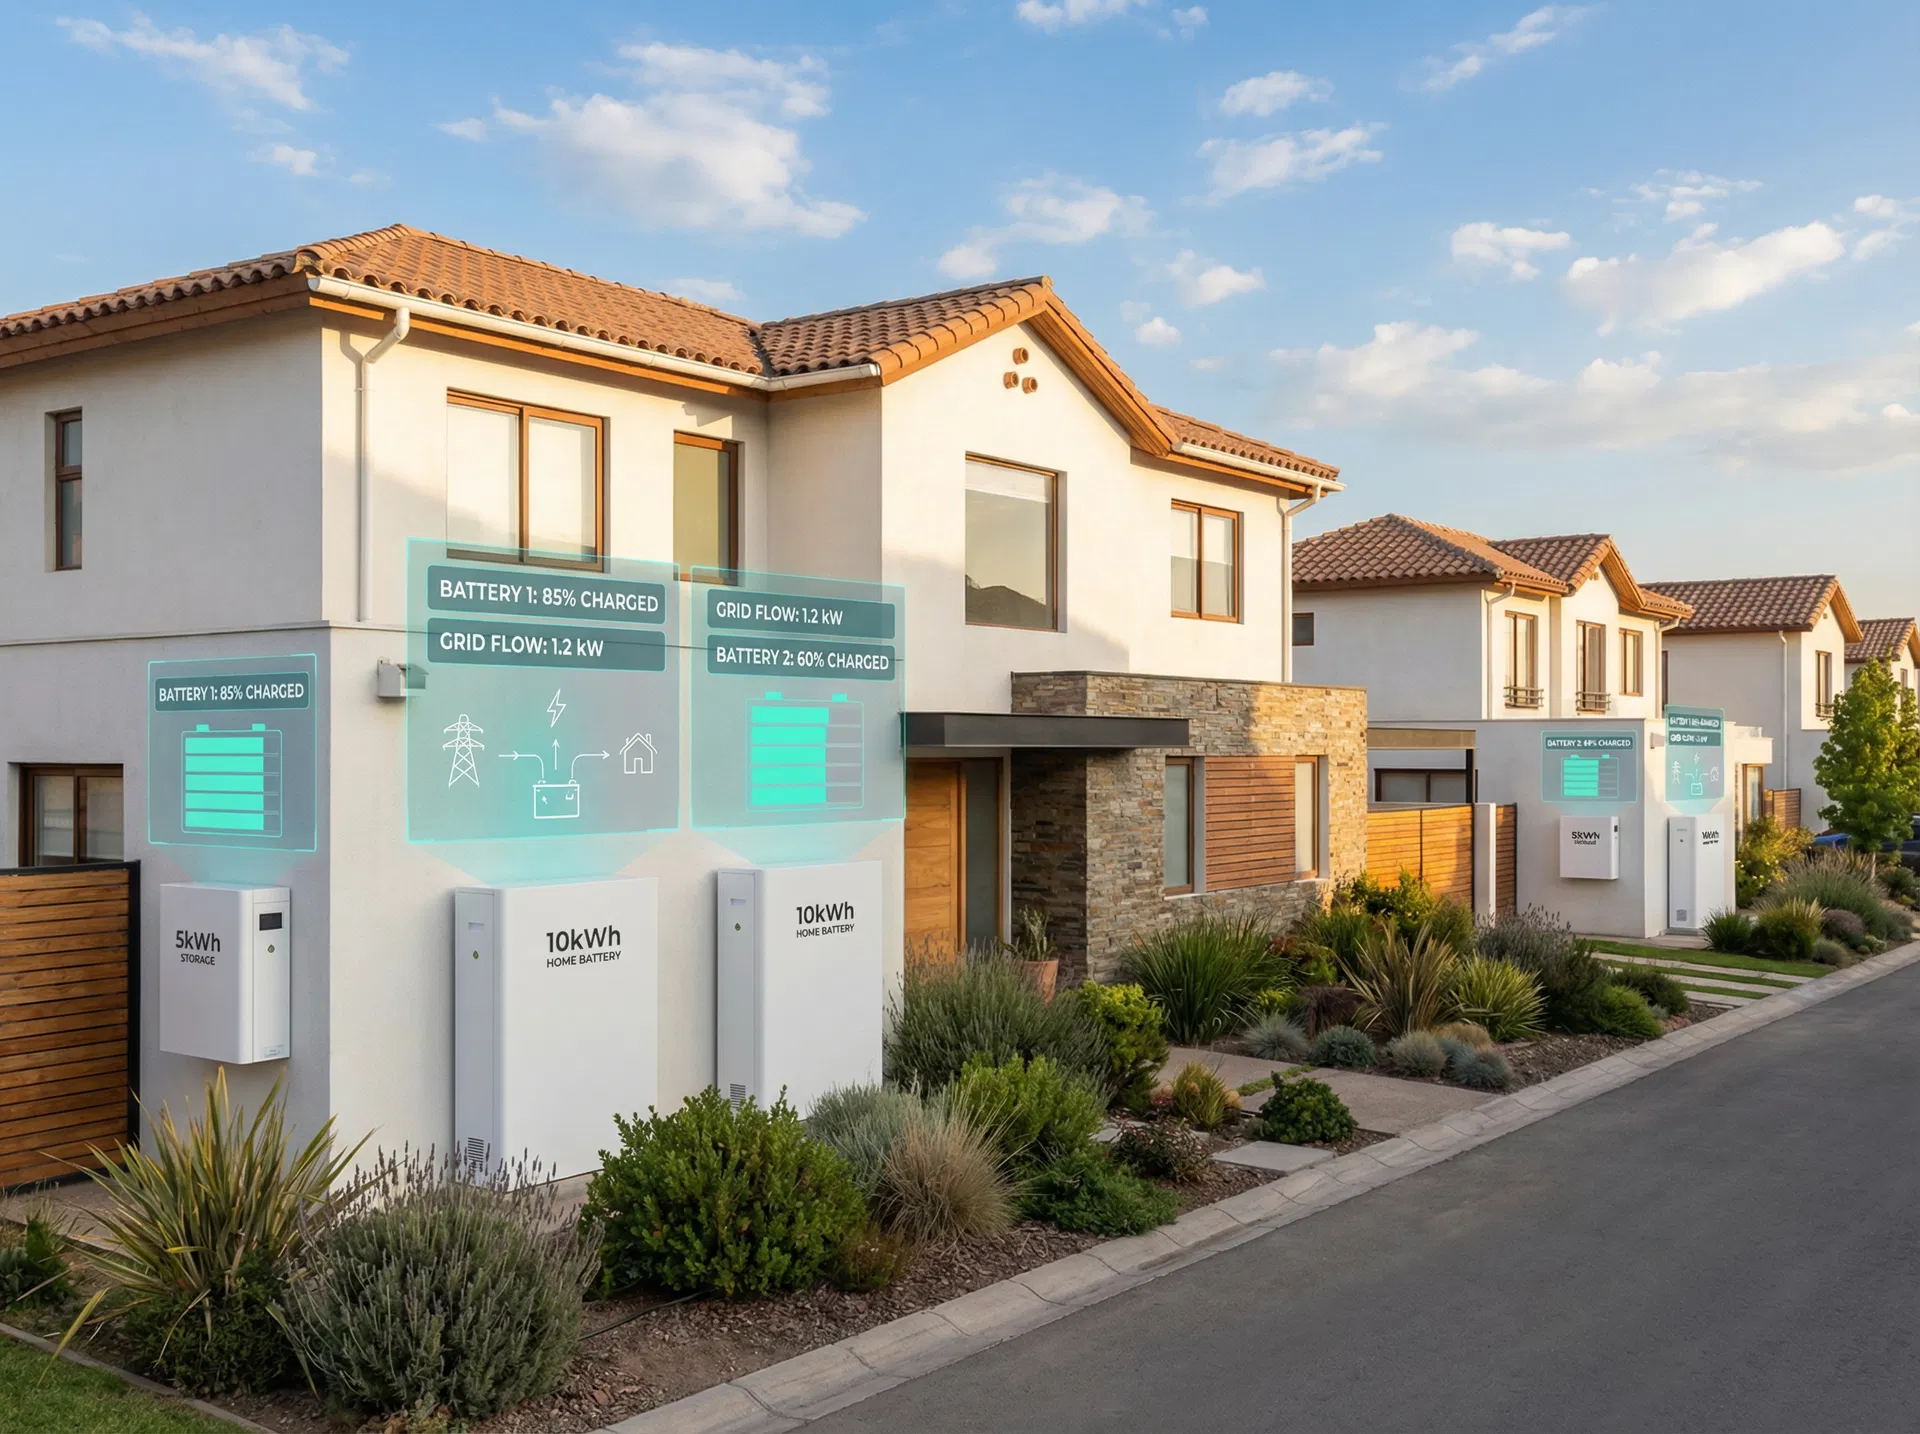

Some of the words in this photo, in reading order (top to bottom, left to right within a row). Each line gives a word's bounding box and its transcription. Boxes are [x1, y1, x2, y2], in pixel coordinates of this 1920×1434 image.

[440, 579, 522, 602] BATTERY
[526, 586, 538, 604] 1:
[542, 587, 577, 607] 85%
[580, 591, 659, 612] CHARGED
[716, 601, 752, 619] GRID
[755, 604, 799, 623] FLOW:
[802, 607, 819, 624] 1.2
[822, 609, 843, 626] kW
[440, 632, 485, 652] GRID
[491, 634, 547, 654] FLOW:
[551, 638, 572, 656] 1.2
[576, 639, 604, 657] kW
[716, 646, 780, 665] BATTERY
[782, 650, 794, 666] 2:
[797, 650, 825, 667] 60%
[827, 652, 889, 670] CHARGED
[159, 686, 209, 702] BATTERY
[210, 686, 218, 701] 1:
[220, 684, 243, 700] 85%
[245, 683, 304, 700] CHARGED
[796, 901, 854, 925] 10kWh
[175, 930, 220, 952] 5kWh
[546, 924, 621, 953] 10kWh
[796, 927, 820, 938] HOME
[821, 923, 855, 935] BATTERY
[546, 955, 577, 968] HOME
[579, 950, 622, 965] BATTERY
